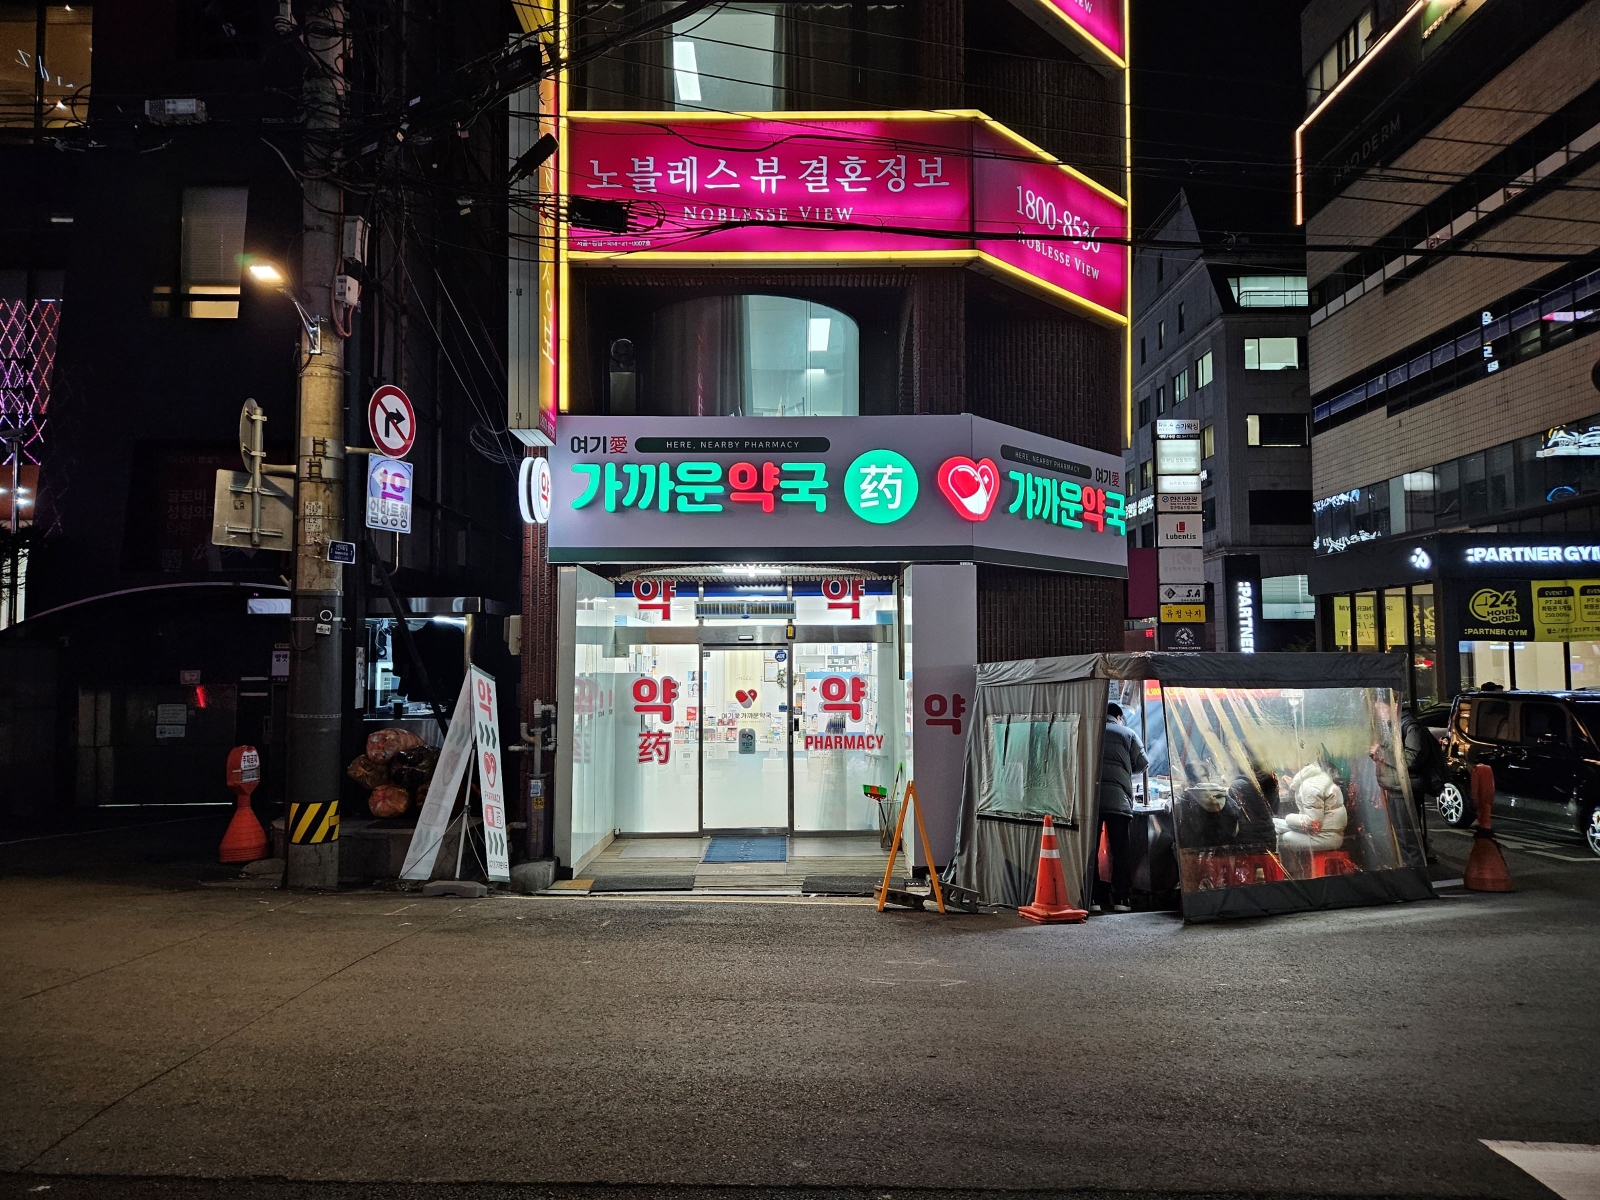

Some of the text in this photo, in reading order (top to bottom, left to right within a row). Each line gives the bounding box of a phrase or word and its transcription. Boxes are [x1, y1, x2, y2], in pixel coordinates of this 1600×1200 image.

[586, 154, 951, 194] 노블레스뷰 결혼정보
[683, 206, 854, 222] NOBLESSE VIEW
[1073, 257, 1100, 280] VIEW
[570, 435, 629, 455] 여기愛
[665, 440, 801, 450] HERE, NEARBY PHARMACY
[1014, 450, 1081, 474] HERE, NEARBY PHARMACY
[570, 461, 829, 513] 가까운약국
[859, 465, 904, 509] 药
[1008, 469, 1126, 536] 가까운약국
[632, 577, 677, 621] 약
[821, 577, 866, 620] 약
[1487, 609, 1516, 617] HOUR
[1488, 590, 1515, 609] 24
[1490, 615, 1519, 623] OPEN
[477, 678, 493, 723] 약
[632, 675, 681, 723] 약
[820, 676, 868, 722] 약
[924, 693, 966, 735] 약
[637, 730, 671, 765] 药
[804, 734, 884, 750] PHARMACY
